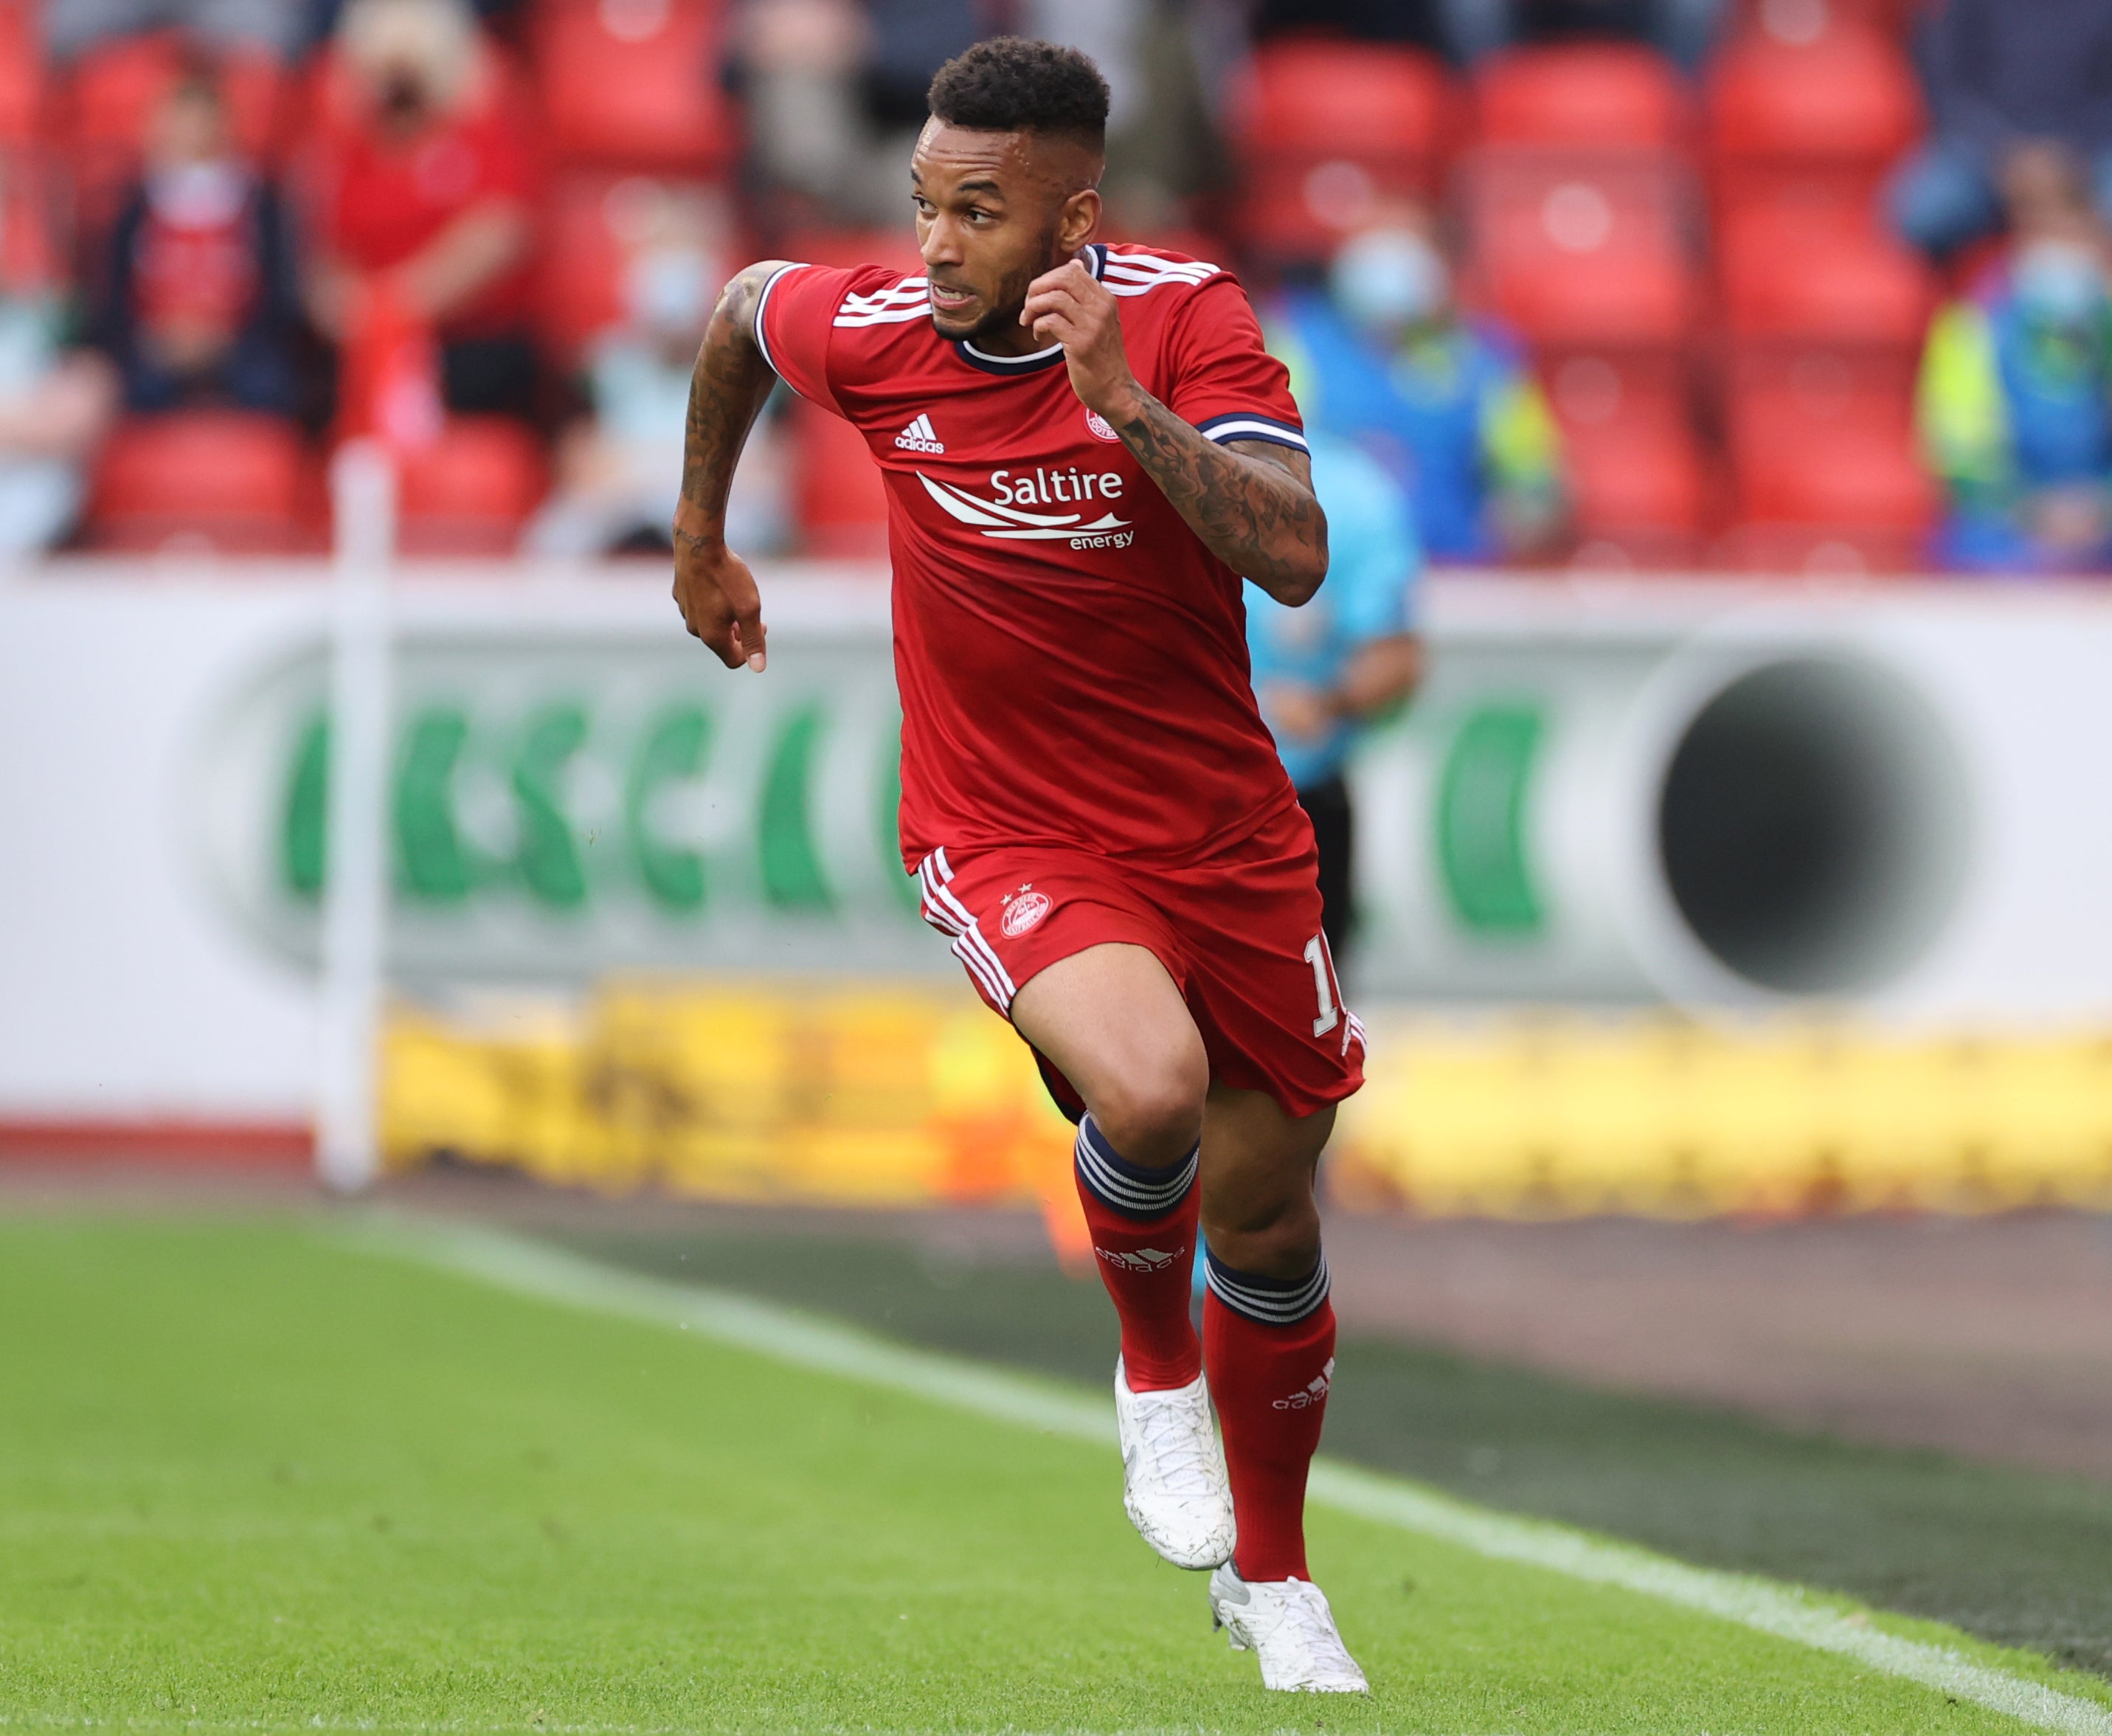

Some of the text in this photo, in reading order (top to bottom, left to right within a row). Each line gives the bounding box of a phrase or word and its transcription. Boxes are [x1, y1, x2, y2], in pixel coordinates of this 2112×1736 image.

[895, 436, 944, 454] adidas
[990, 467, 1123, 505] Saltire
[1070, 530, 1134, 550] energy
[1303, 934, 1351, 1057] 1
[1095, 1246, 1185, 1273] adidas
[1272, 1384, 1329, 1410] adid
